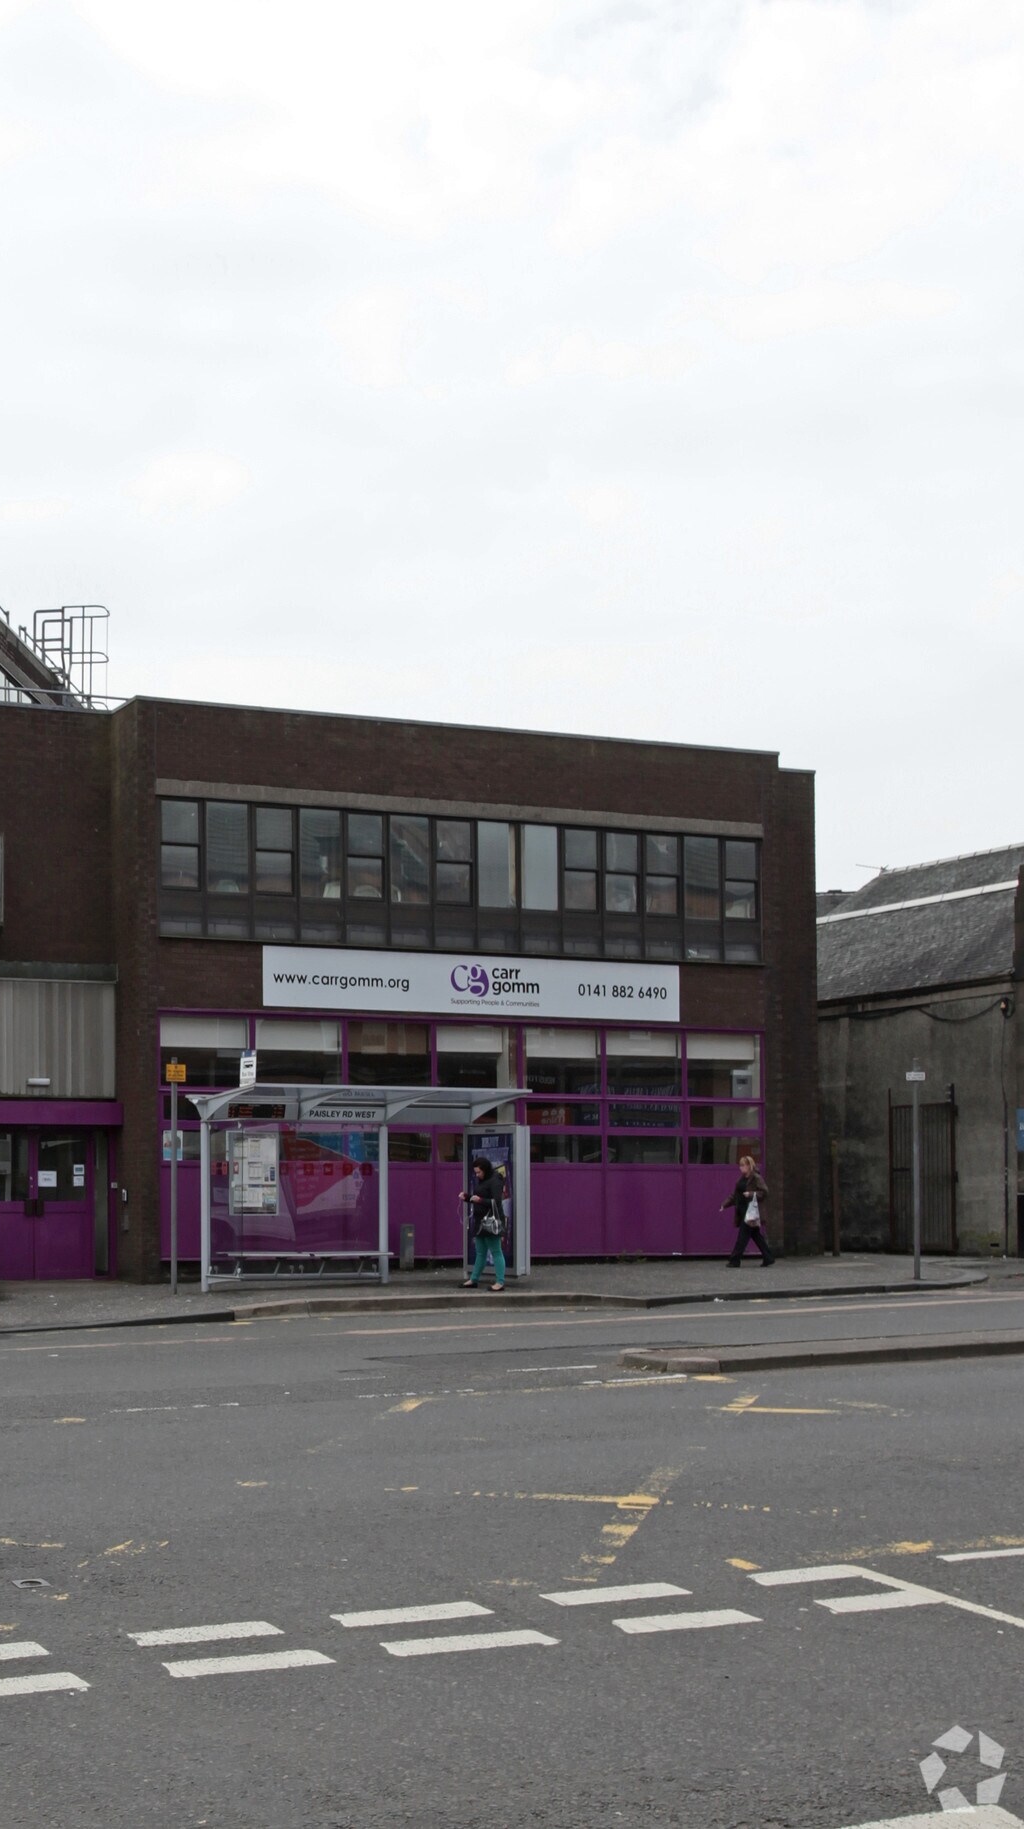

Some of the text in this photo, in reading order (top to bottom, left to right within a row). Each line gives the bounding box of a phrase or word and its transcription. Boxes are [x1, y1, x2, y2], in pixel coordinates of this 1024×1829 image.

[492, 968, 520, 979] carr
[273, 973, 410, 992] www.carrgomm.org
[492, 981, 540, 995] gomm
[578, 983, 667, 1000] 0141 882 6490
[309, 1110, 376, 1118] PAISLEY RD WEST
